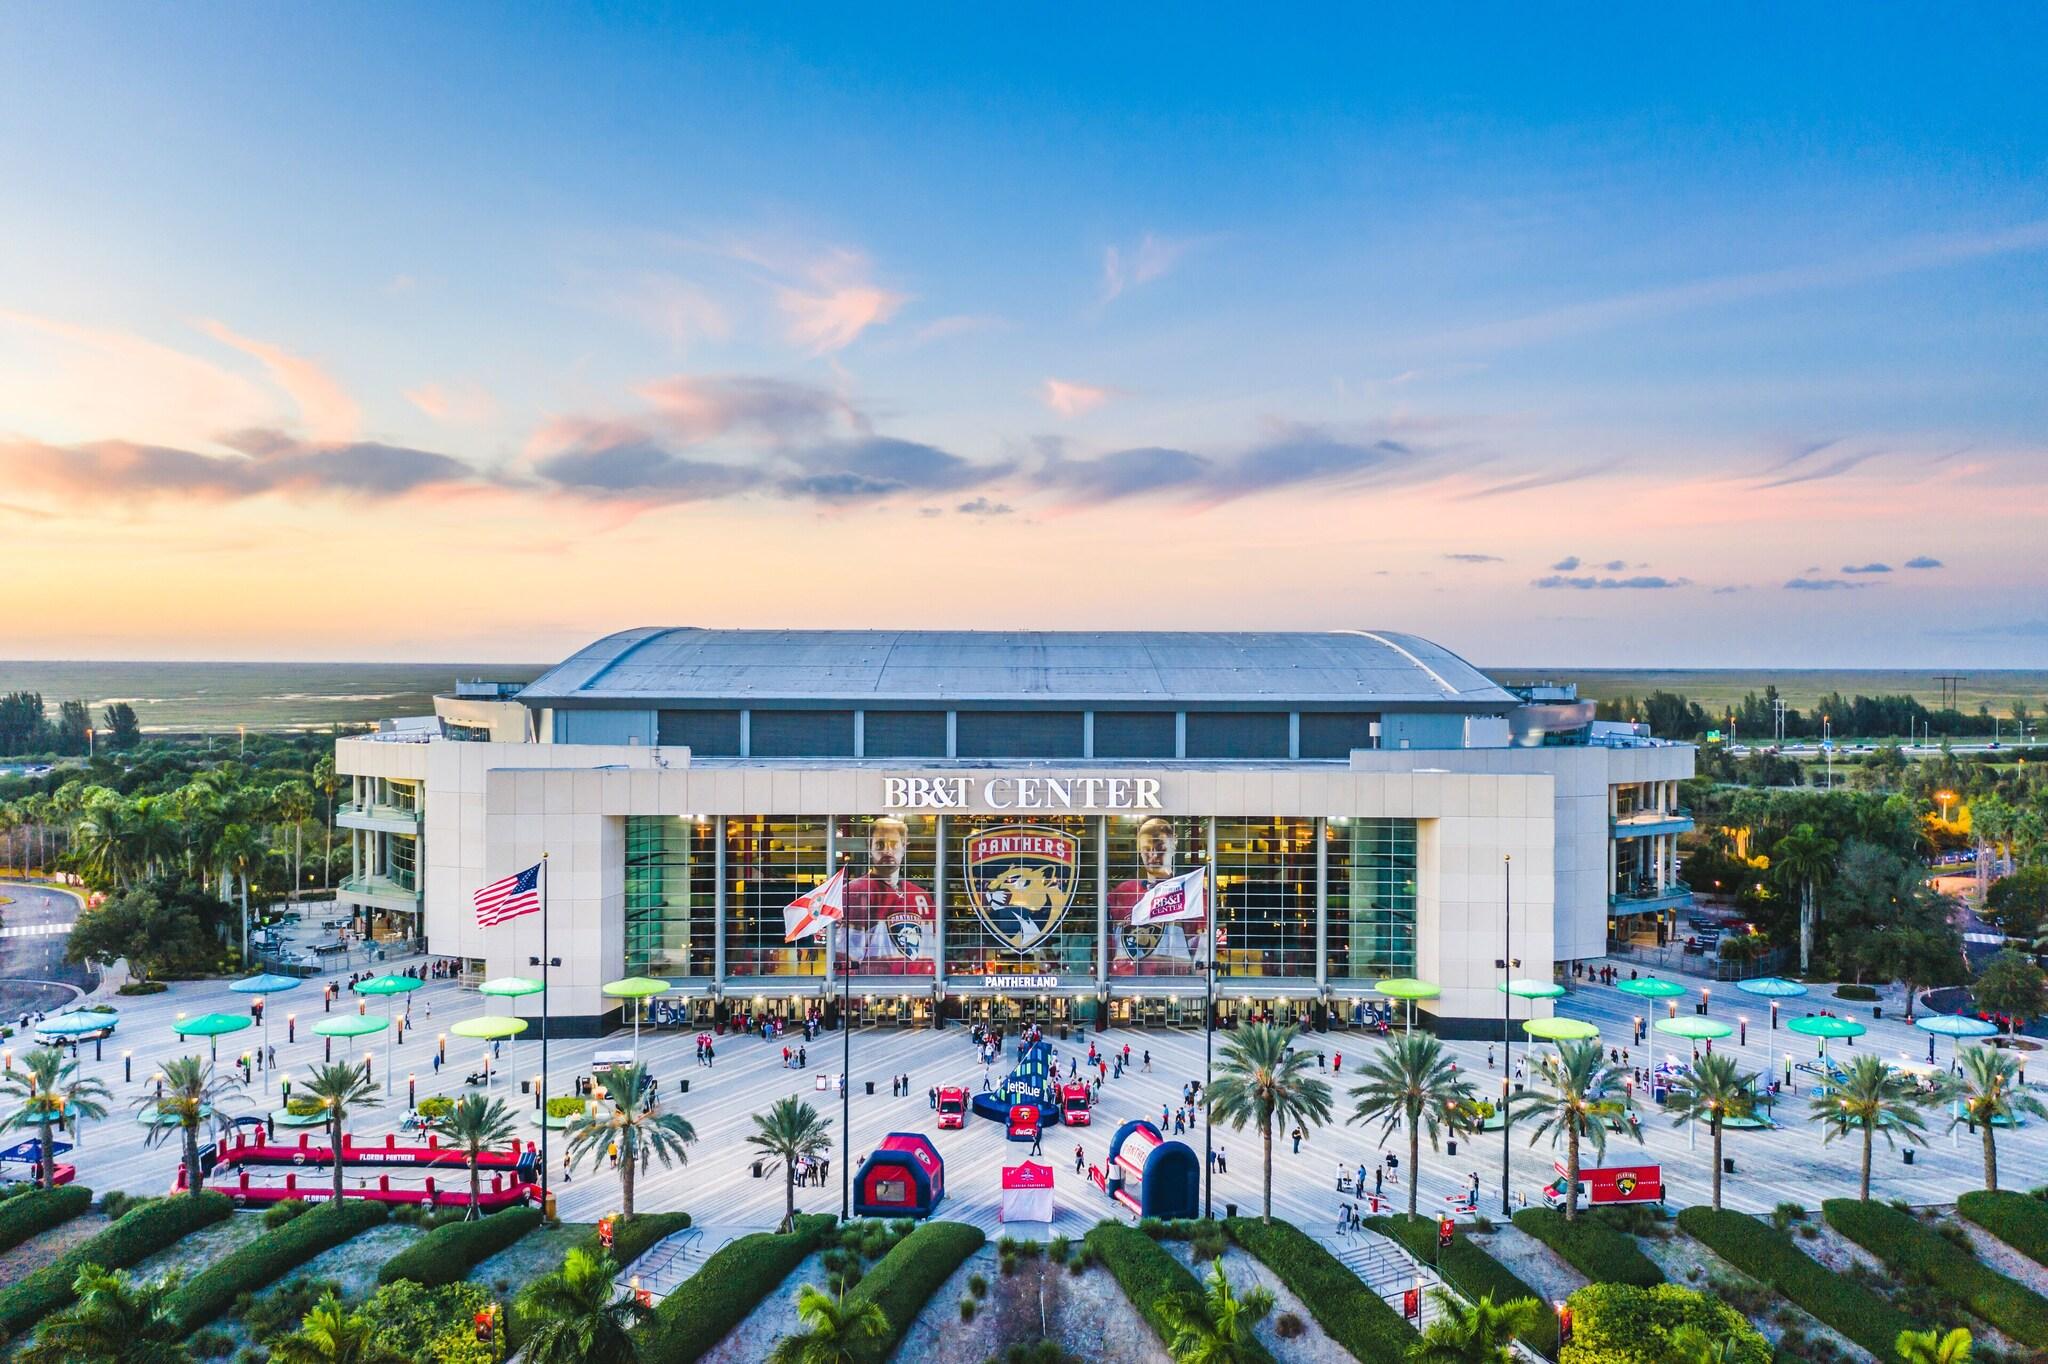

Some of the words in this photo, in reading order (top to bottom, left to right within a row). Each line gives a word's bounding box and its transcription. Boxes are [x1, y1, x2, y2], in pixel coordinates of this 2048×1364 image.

[883, 777, 974, 809] BB&T
[984, 777, 1163, 809] CENTER
[978, 837, 1066, 858] PANTHERS
[1152, 893, 1183, 910] BB&T
[1152, 903, 1183, 915] CENTER
[985, 976, 1058, 987] PANTHERLAND
[1007, 1079, 1041, 1097] jetBlue
[359, 1153, 384, 1161] FLORIDA
